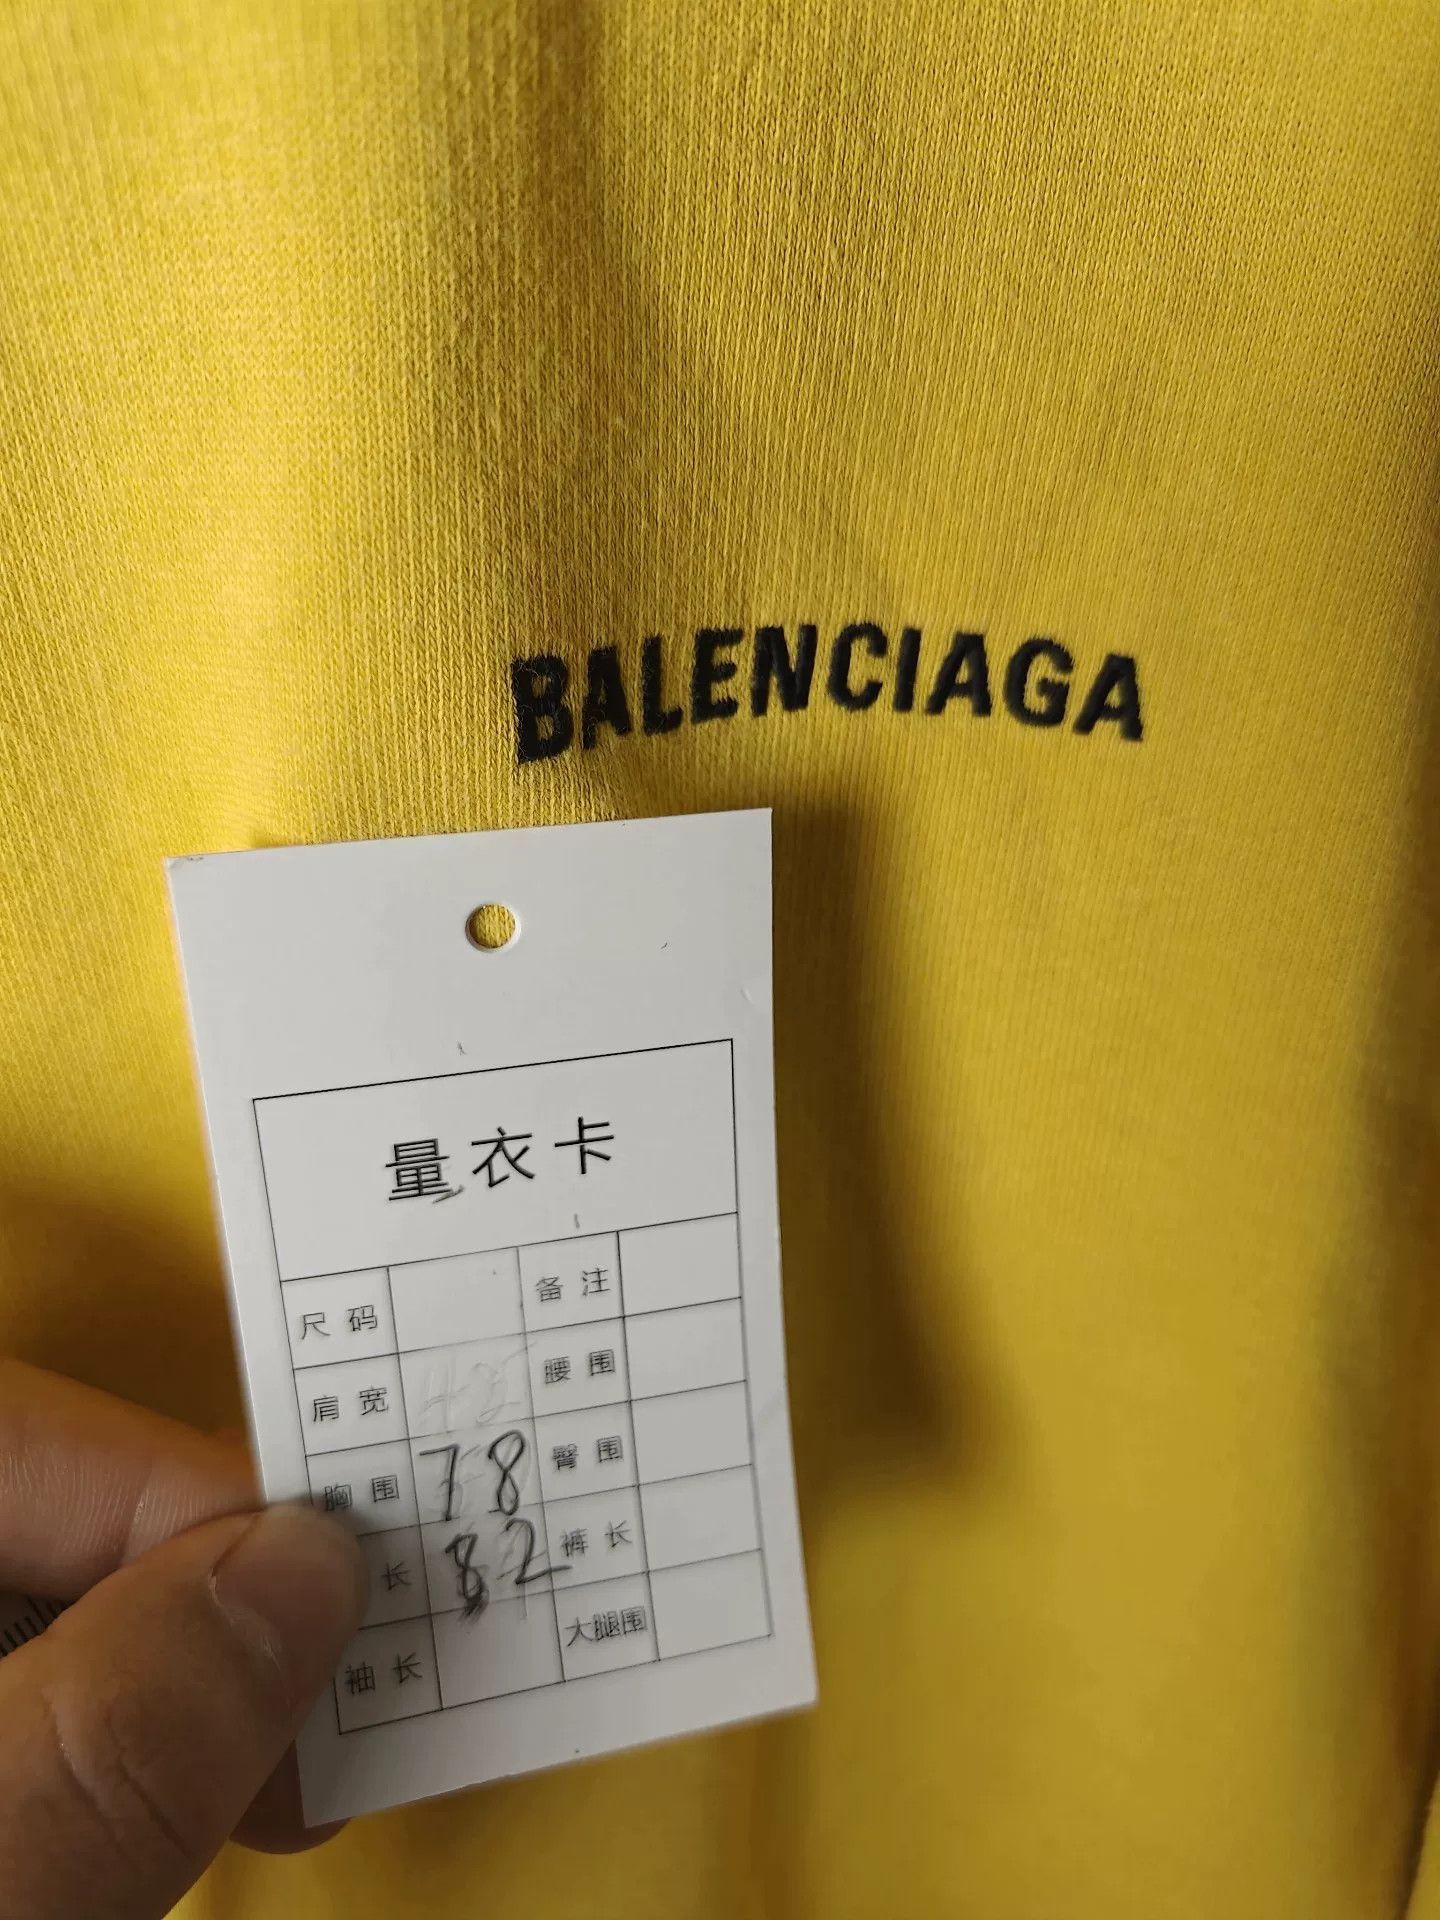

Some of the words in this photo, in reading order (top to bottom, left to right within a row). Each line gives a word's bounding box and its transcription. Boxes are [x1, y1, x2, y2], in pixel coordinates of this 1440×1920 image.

[510, 622, 1144, 764] BALENCIAGA
[385, 1117, 615, 1201] 量衣卡
[536, 1267, 611, 1303] 备注
[300, 1304, 379, 1341] 尺码
[543, 1349, 616, 1385] 腰围
[312, 1385, 390, 1423] 肩宽
[323, 1474, 400, 1513] 胸围
[418, 1429, 526, 1522] 78
[560, 1518, 633, 1558] 裤长
[563, 1605, 649, 1648] 大腿围
[345, 1651, 424, 1695] 袖长
